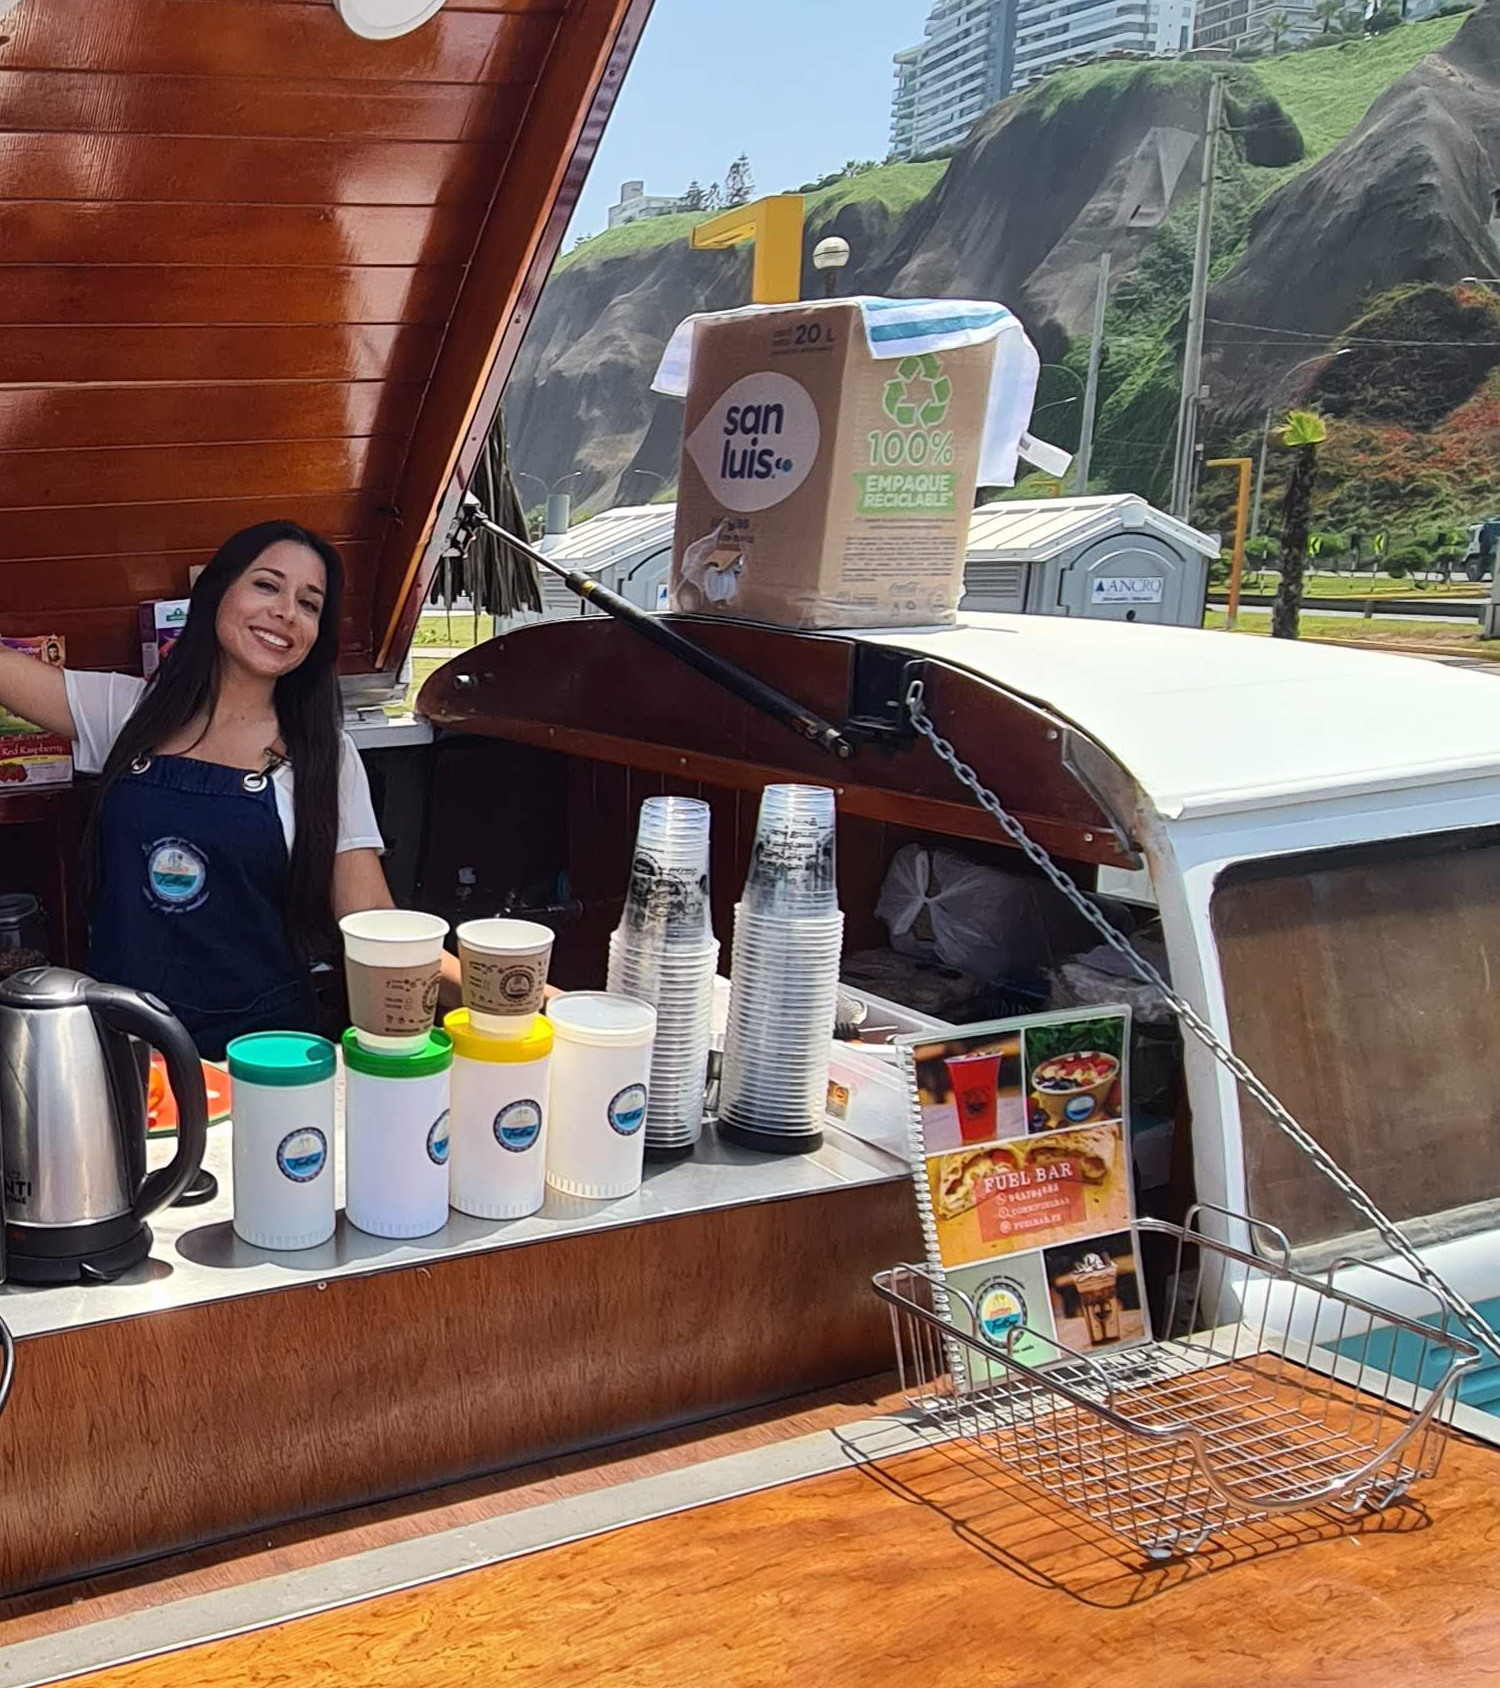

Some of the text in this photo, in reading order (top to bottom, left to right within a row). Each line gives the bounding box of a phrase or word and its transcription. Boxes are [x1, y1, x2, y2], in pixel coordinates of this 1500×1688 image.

[795, 323, 821, 345] 20
[723, 403, 784, 436] san
[867, 429, 954, 466] 100%
[865, 474, 951, 493] EMPAQUE
[1, 741, 63, 757] Red Raspberry
[984, 1170, 1031, 1194] FUEL
[1035, 1162, 1074, 1183] BAR
